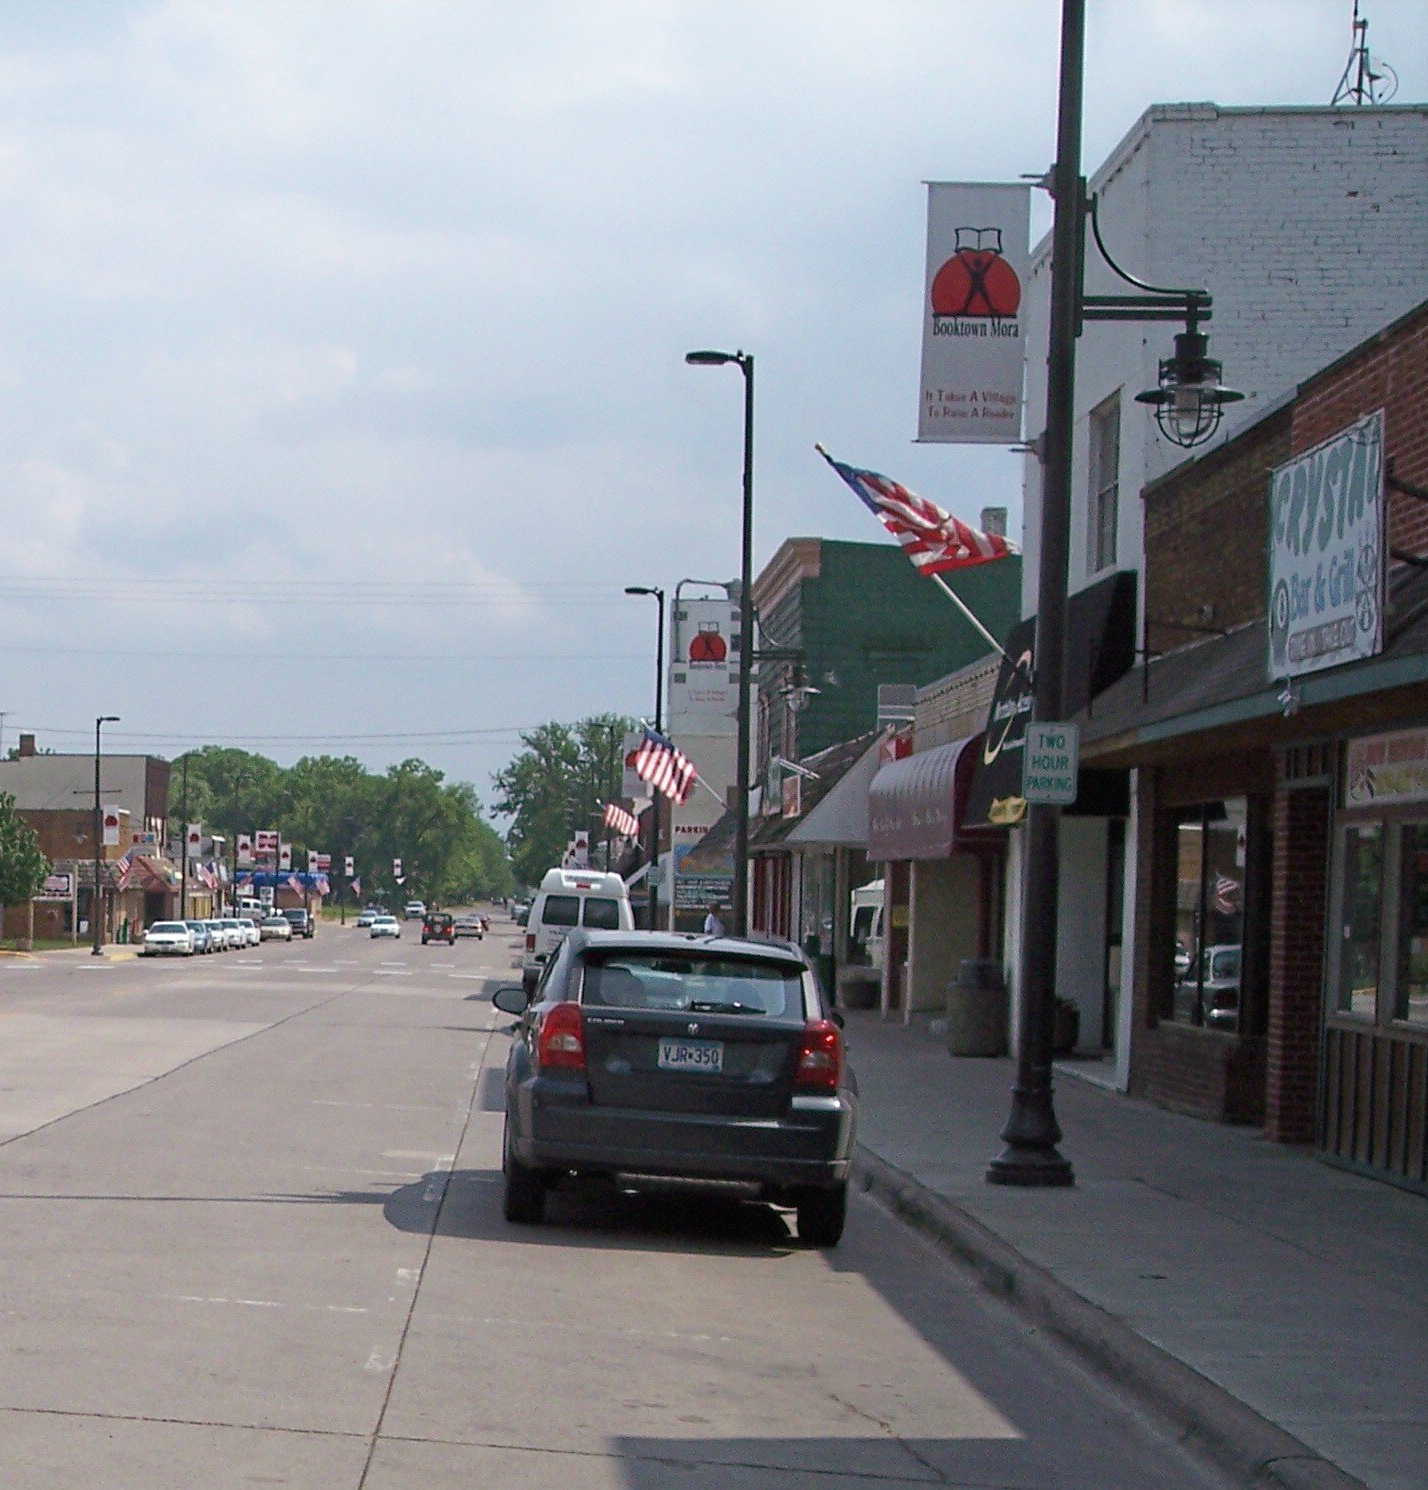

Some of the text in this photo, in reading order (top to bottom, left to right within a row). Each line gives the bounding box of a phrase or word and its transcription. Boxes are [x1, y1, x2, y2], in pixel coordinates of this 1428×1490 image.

[933, 316, 1019, 338] Booktown Mora
[969, 391, 978, 402] A
[1038, 733, 1065, 749] TWO
[1033, 754, 1070, 770] HOUR
[1027, 776, 1072, 790] PARKING
[675, 826, 710, 834] PARKIN
